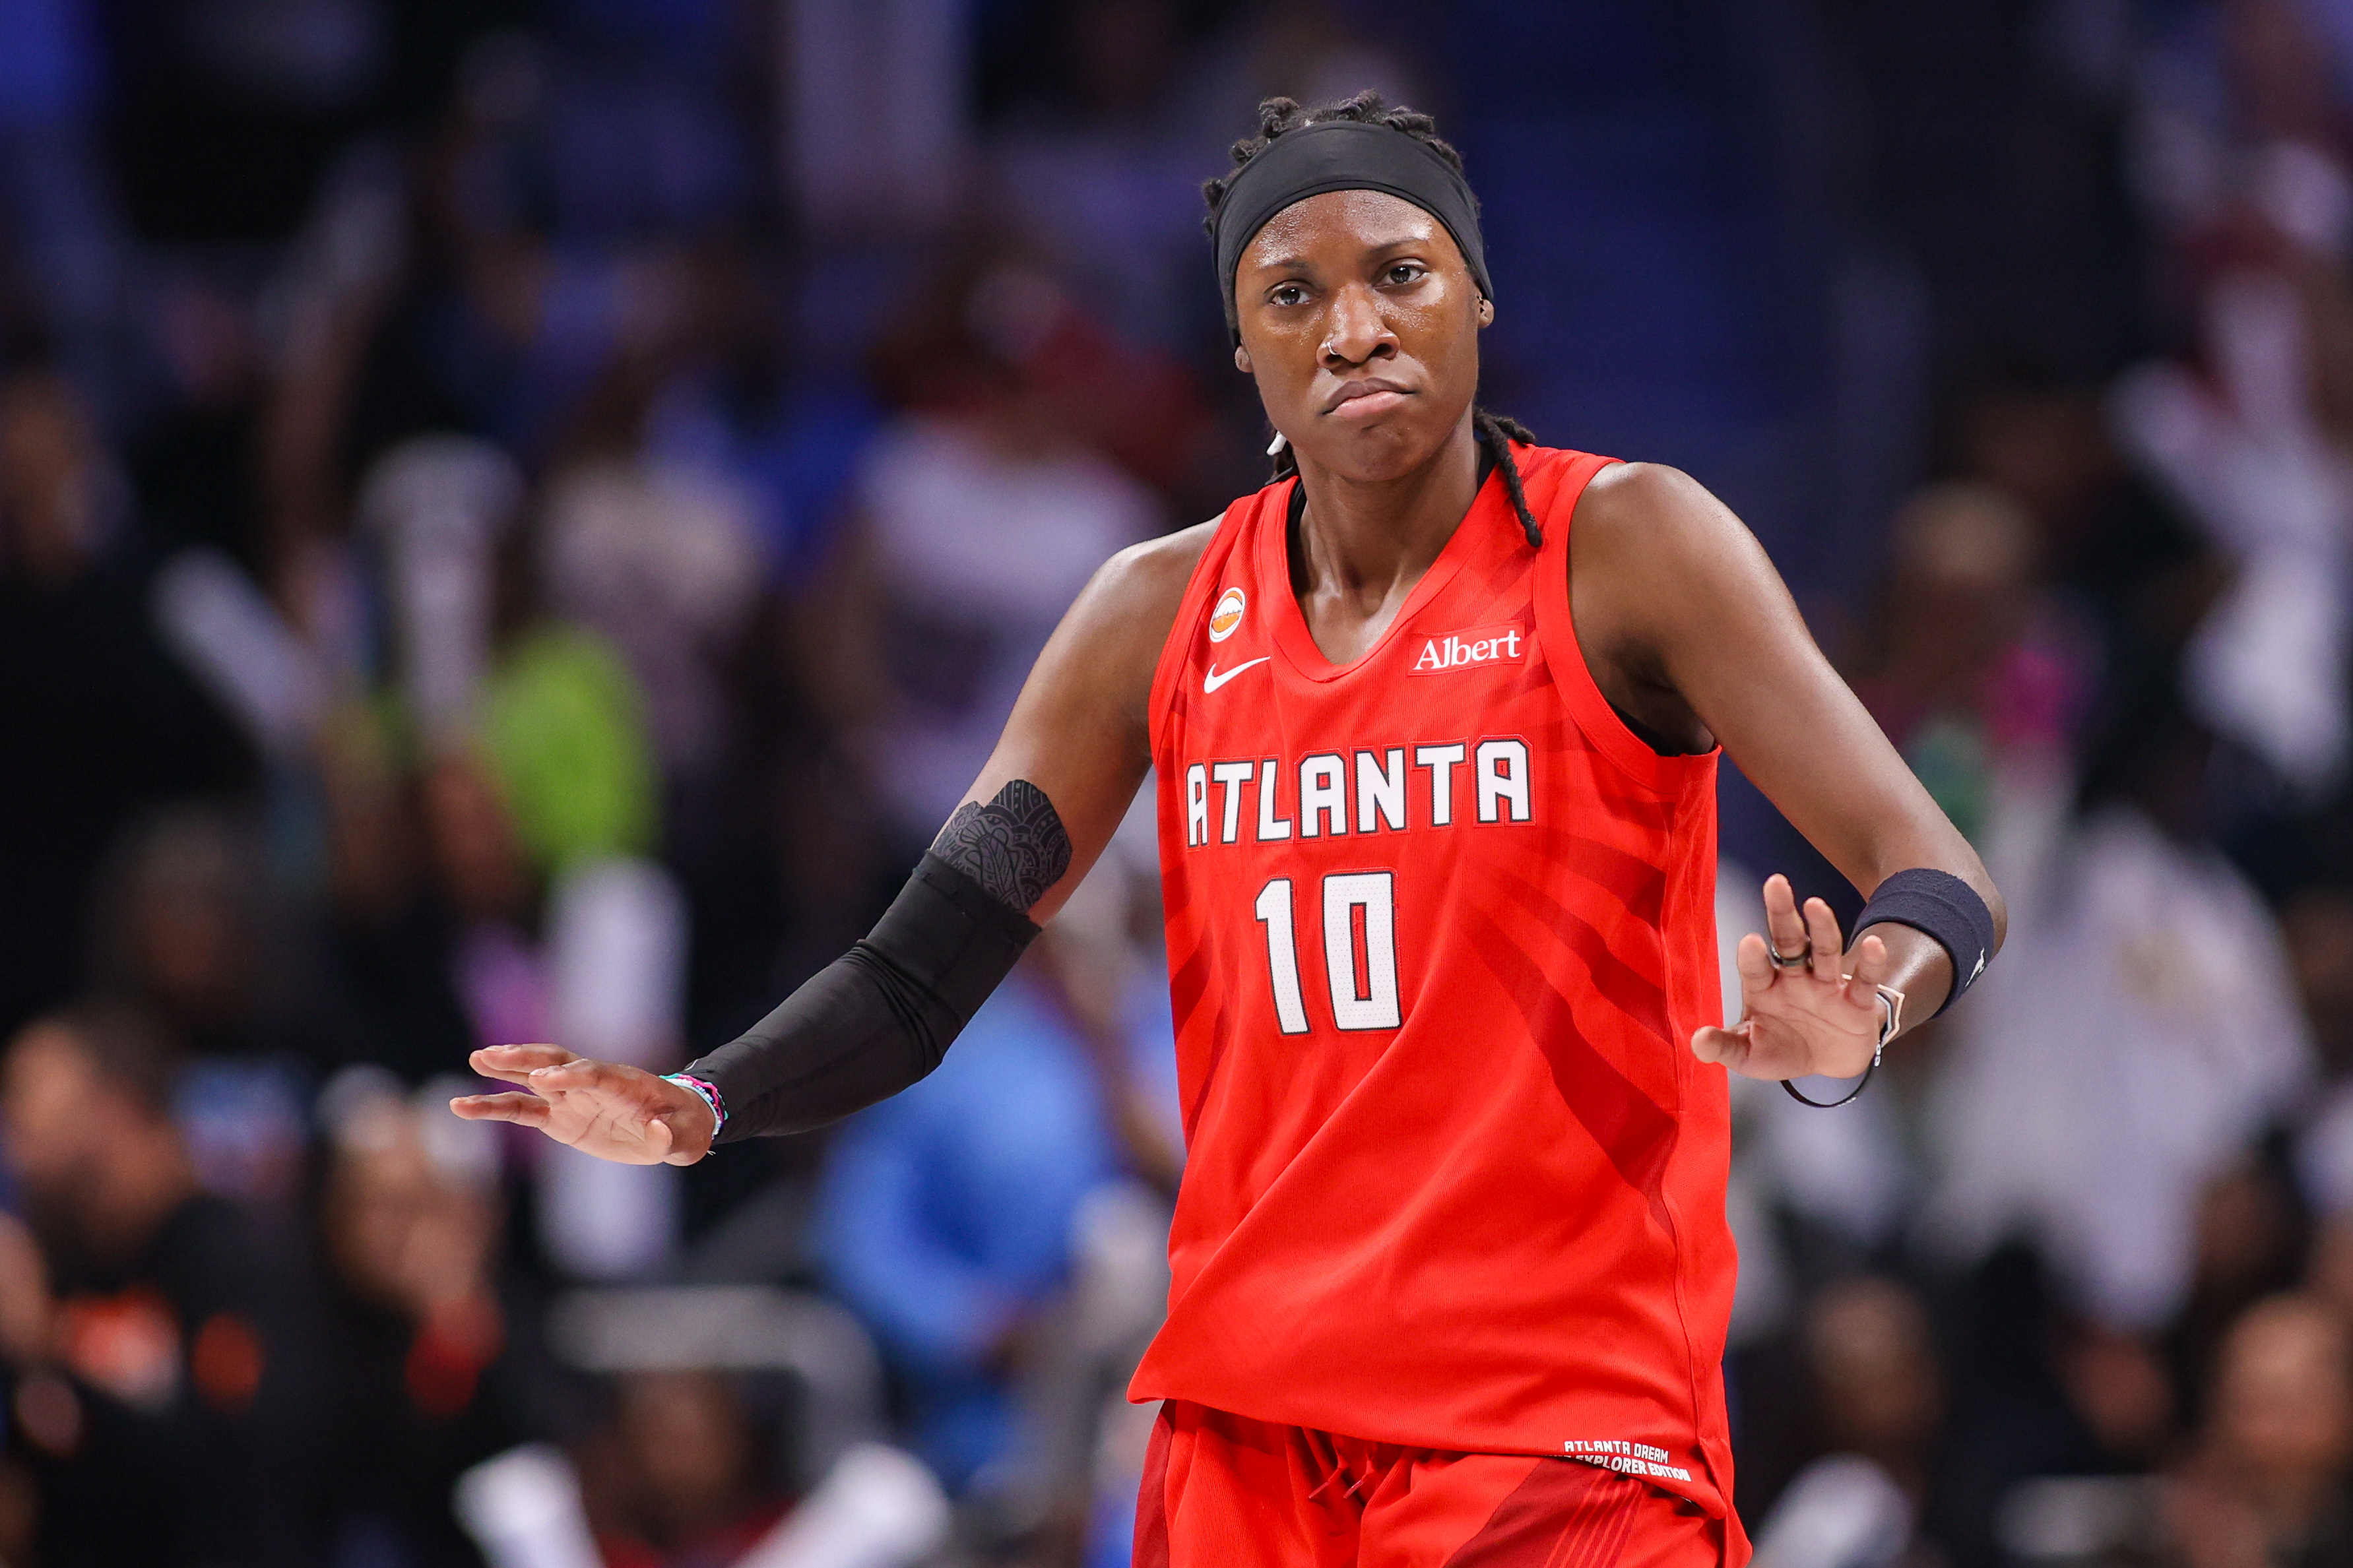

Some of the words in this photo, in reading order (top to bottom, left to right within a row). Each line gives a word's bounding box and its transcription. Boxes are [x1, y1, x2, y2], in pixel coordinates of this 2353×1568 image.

[1413, 630, 1521, 670] Albert
[1186, 737, 1532, 848] ATLANTA
[1255, 870, 1403, 1035] 10
[1564, 1441, 1630, 1455] ATLANTA
[1634, 1443, 1669, 1464] DREAM
[1648, 1462, 1692, 1482] EDITION
